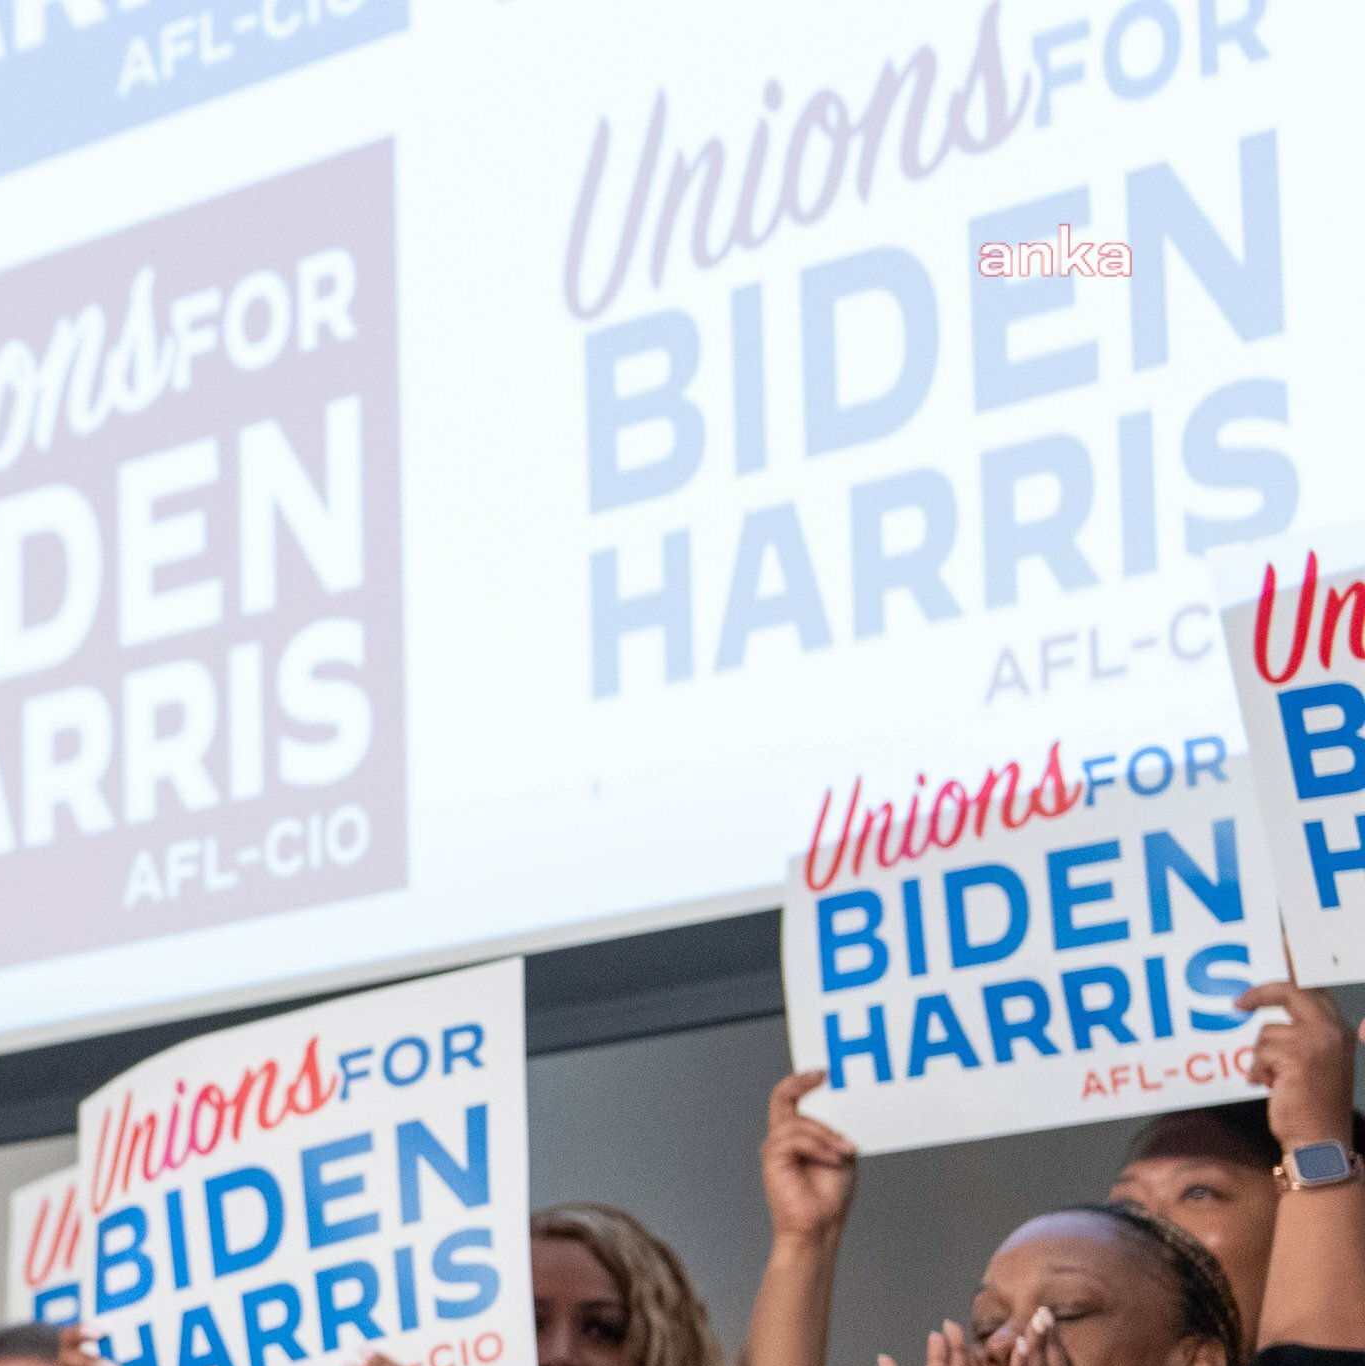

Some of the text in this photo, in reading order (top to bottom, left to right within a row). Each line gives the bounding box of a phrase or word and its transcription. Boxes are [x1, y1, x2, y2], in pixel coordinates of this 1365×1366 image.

[563, 0, 1272, 322] Unions FOR
[170, 248, 357, 392] FOR
[583, 127, 1287, 517] BIDEN
[588, 376, 1301, 700] HARRIS
[120, 804, 370, 908] AFL-CIO
[805, 735, 1228, 892] Unions FOR
[815, 817, 1246, 994] BIDEN
[822, 943, 1254, 1090] HARRIS
[91, 1023, 486, 1214] Unions FOR
[93, 1102, 492, 1315] BIDEN
